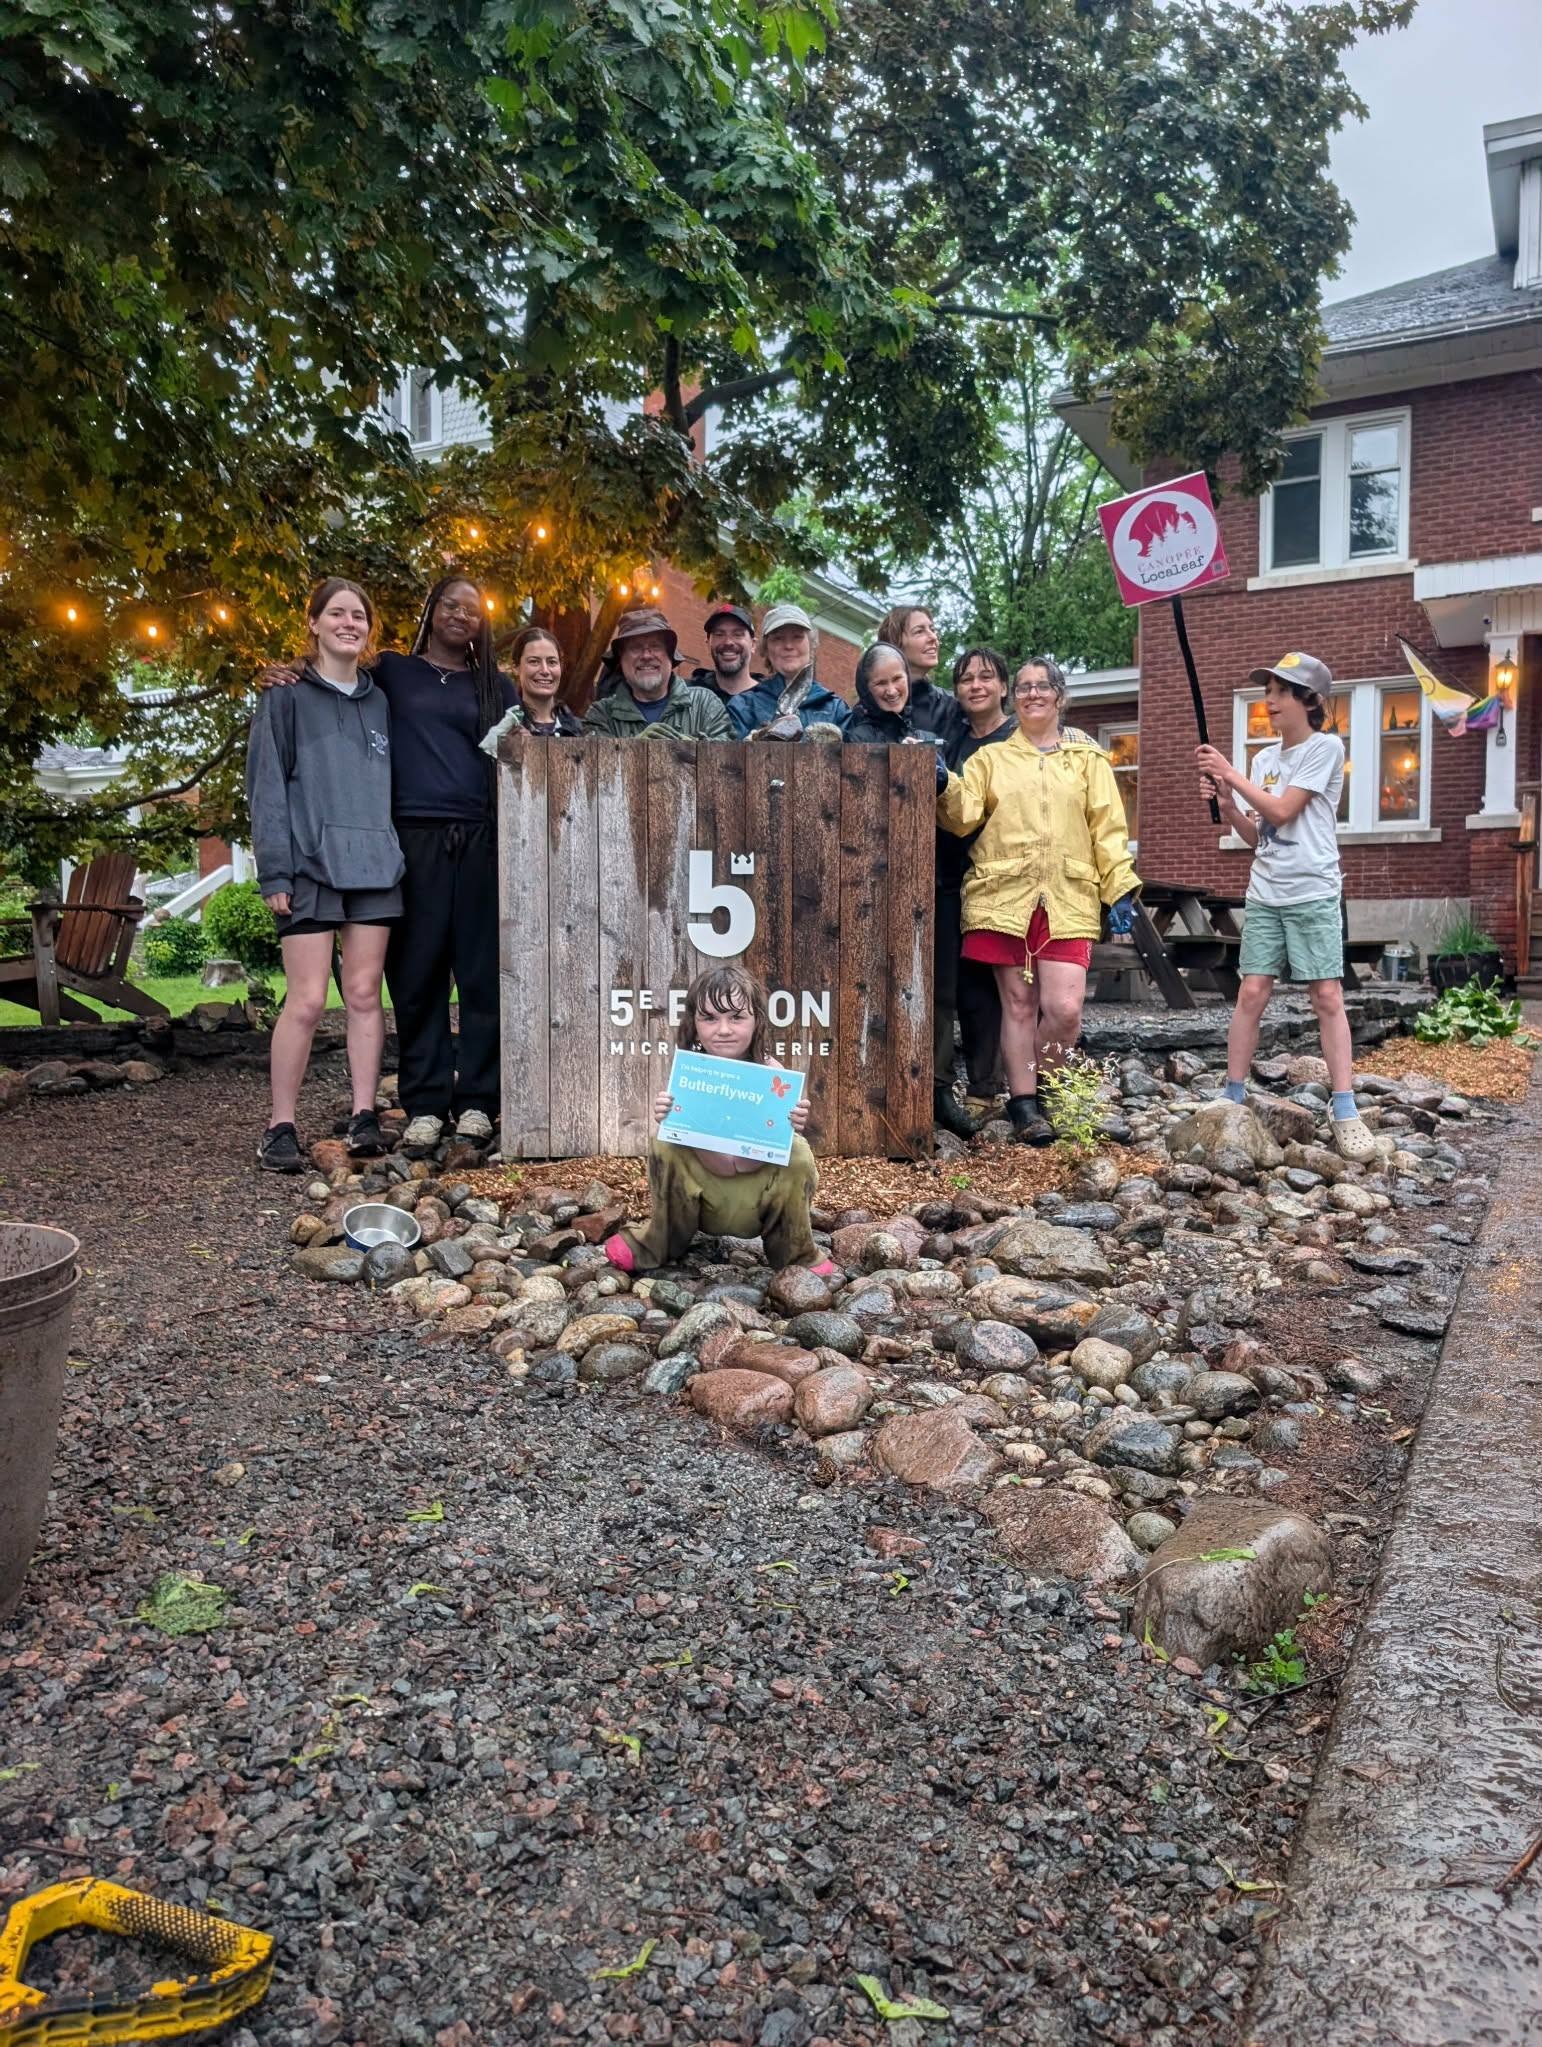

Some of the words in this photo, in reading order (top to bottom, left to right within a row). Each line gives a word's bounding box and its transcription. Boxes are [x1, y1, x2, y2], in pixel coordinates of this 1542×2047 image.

[1140, 555, 1204, 584] Localeaf
[687, 850, 755, 958] 5
[610, 1041, 830, 1056] MICRERIE
[679, 1076, 765, 1104] Butterflyway
